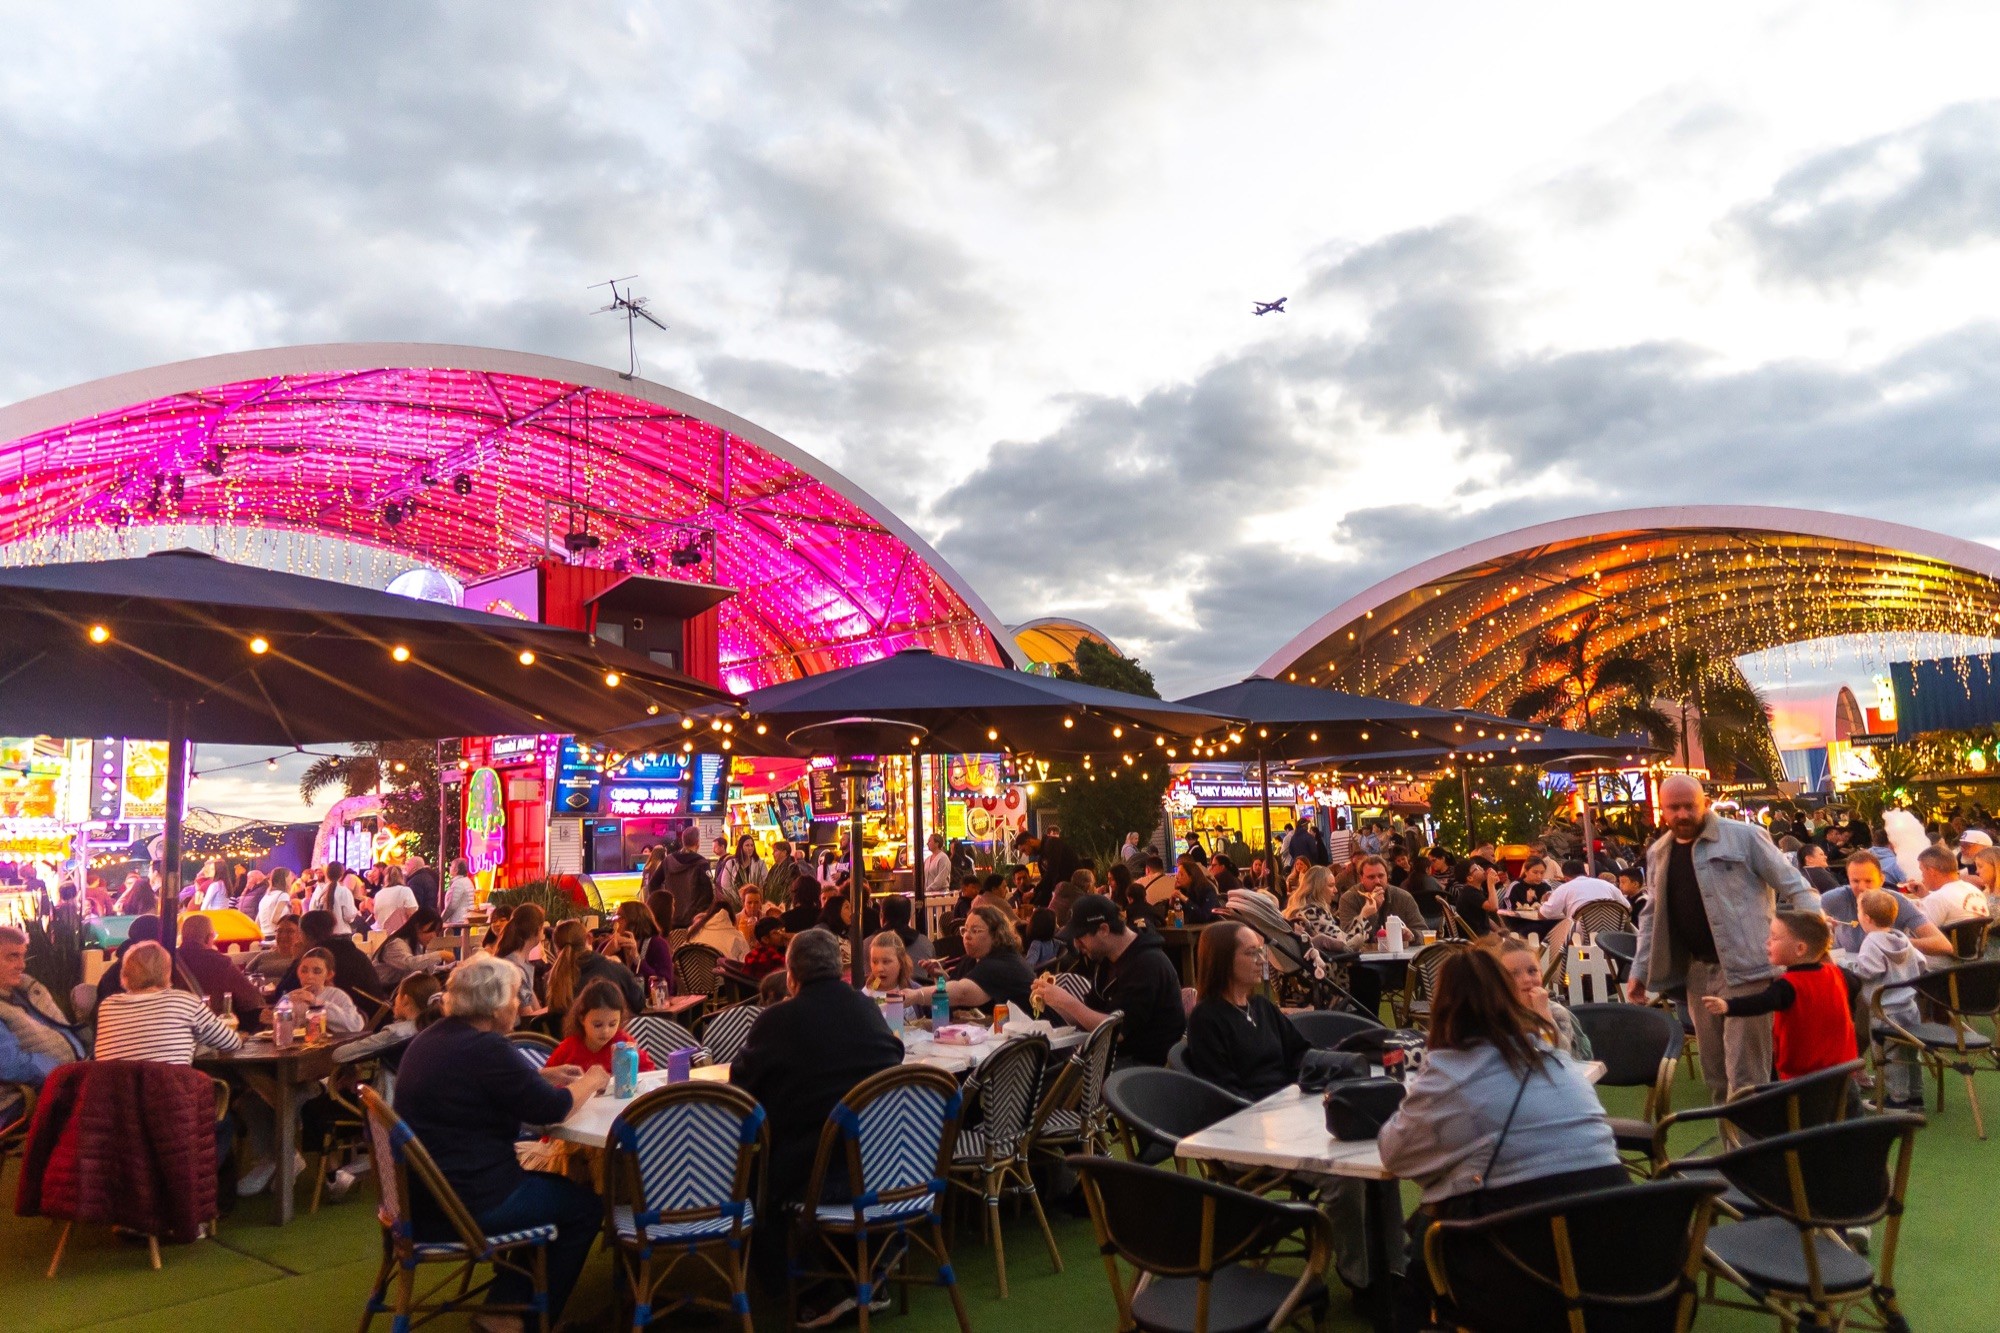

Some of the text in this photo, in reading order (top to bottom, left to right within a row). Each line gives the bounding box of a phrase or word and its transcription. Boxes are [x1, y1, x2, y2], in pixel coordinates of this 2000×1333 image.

[516, 737, 535, 751] Alley
[1852, 736, 1895, 745] WestWharf
[1222, 786, 1252, 797] DRAGON
[1253, 786, 1294, 797] DUPLINGS
